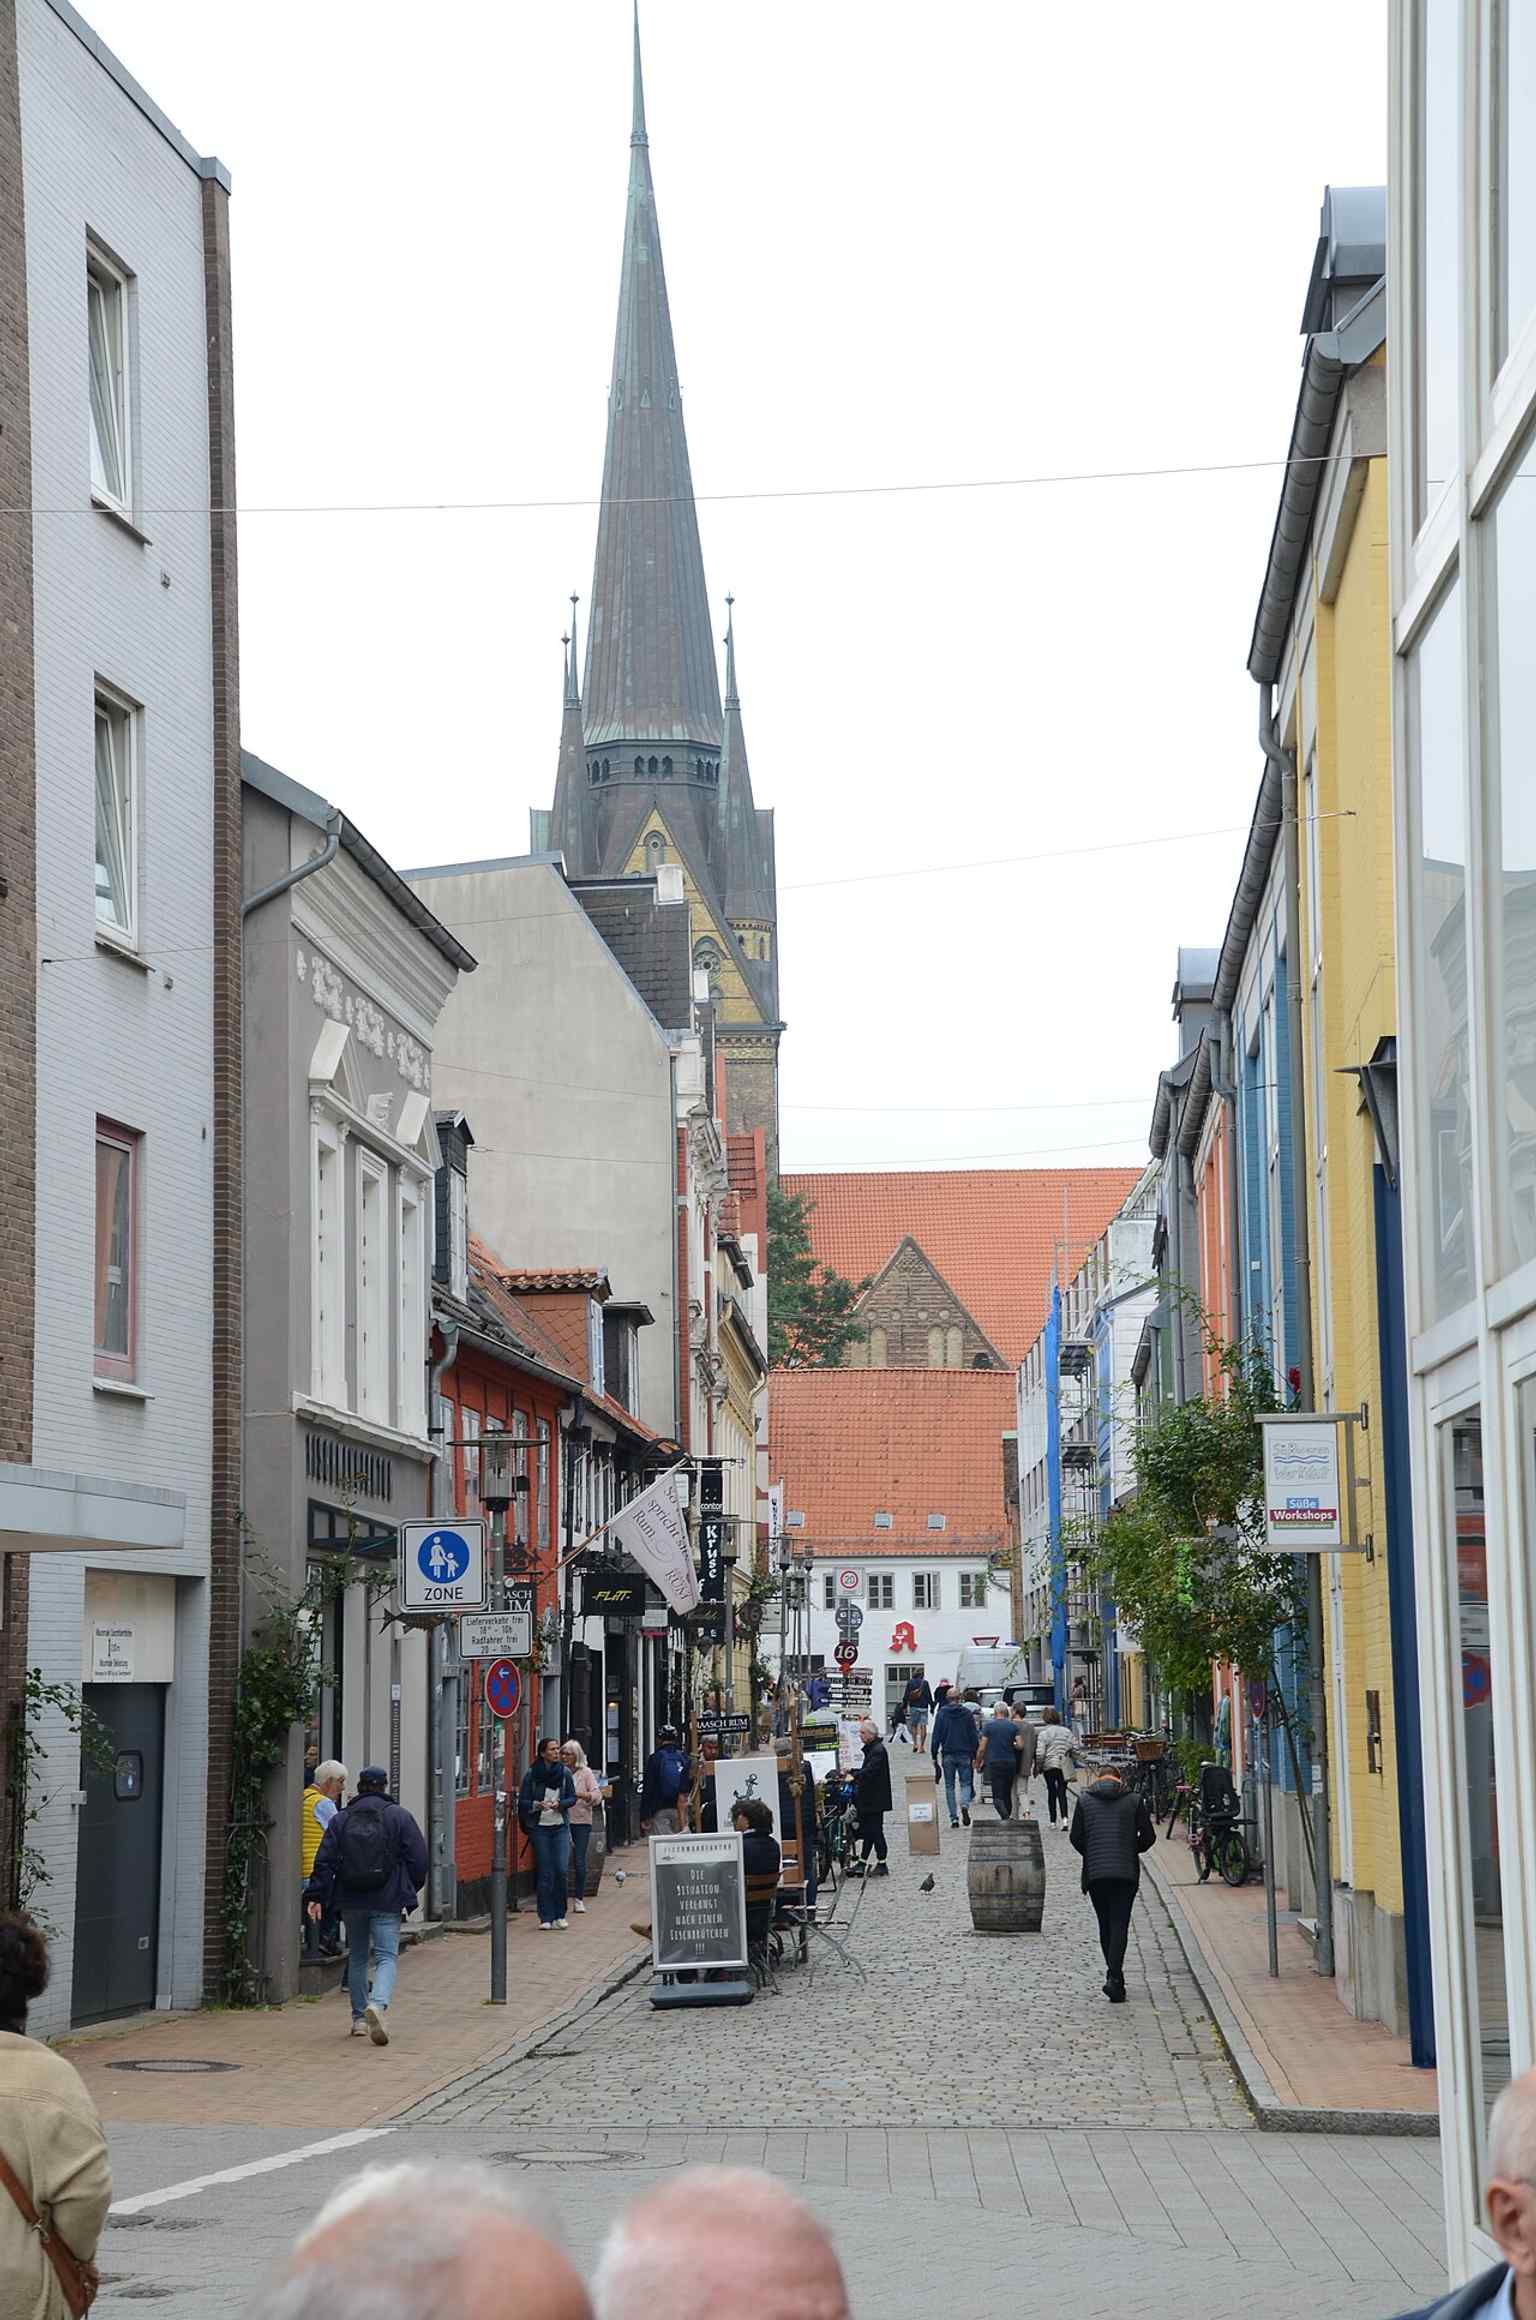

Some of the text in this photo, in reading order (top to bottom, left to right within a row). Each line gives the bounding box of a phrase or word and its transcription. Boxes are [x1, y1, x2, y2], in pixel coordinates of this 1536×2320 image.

[1288, 1499, 1317, 1509] Süße
[1274, 1511, 1333, 1521] Workshops
[632, 1509, 657, 1538] Rum
[706, 1525, 718, 1578] Kruse
[844, 1575, 855, 1585] 20
[424, 1587, 463, 1600] ZONE
[466, 1615, 524, 1626] Lieferverkehr frei
[472, 1635, 518, 1645] Radfahrer frei
[836, 1645, 855, 1659] 16
[690, 1869, 704, 1880] DIE
[676, 1884, 720, 1896] SITUATION
[680, 1899, 718, 1911] VERLANGT
